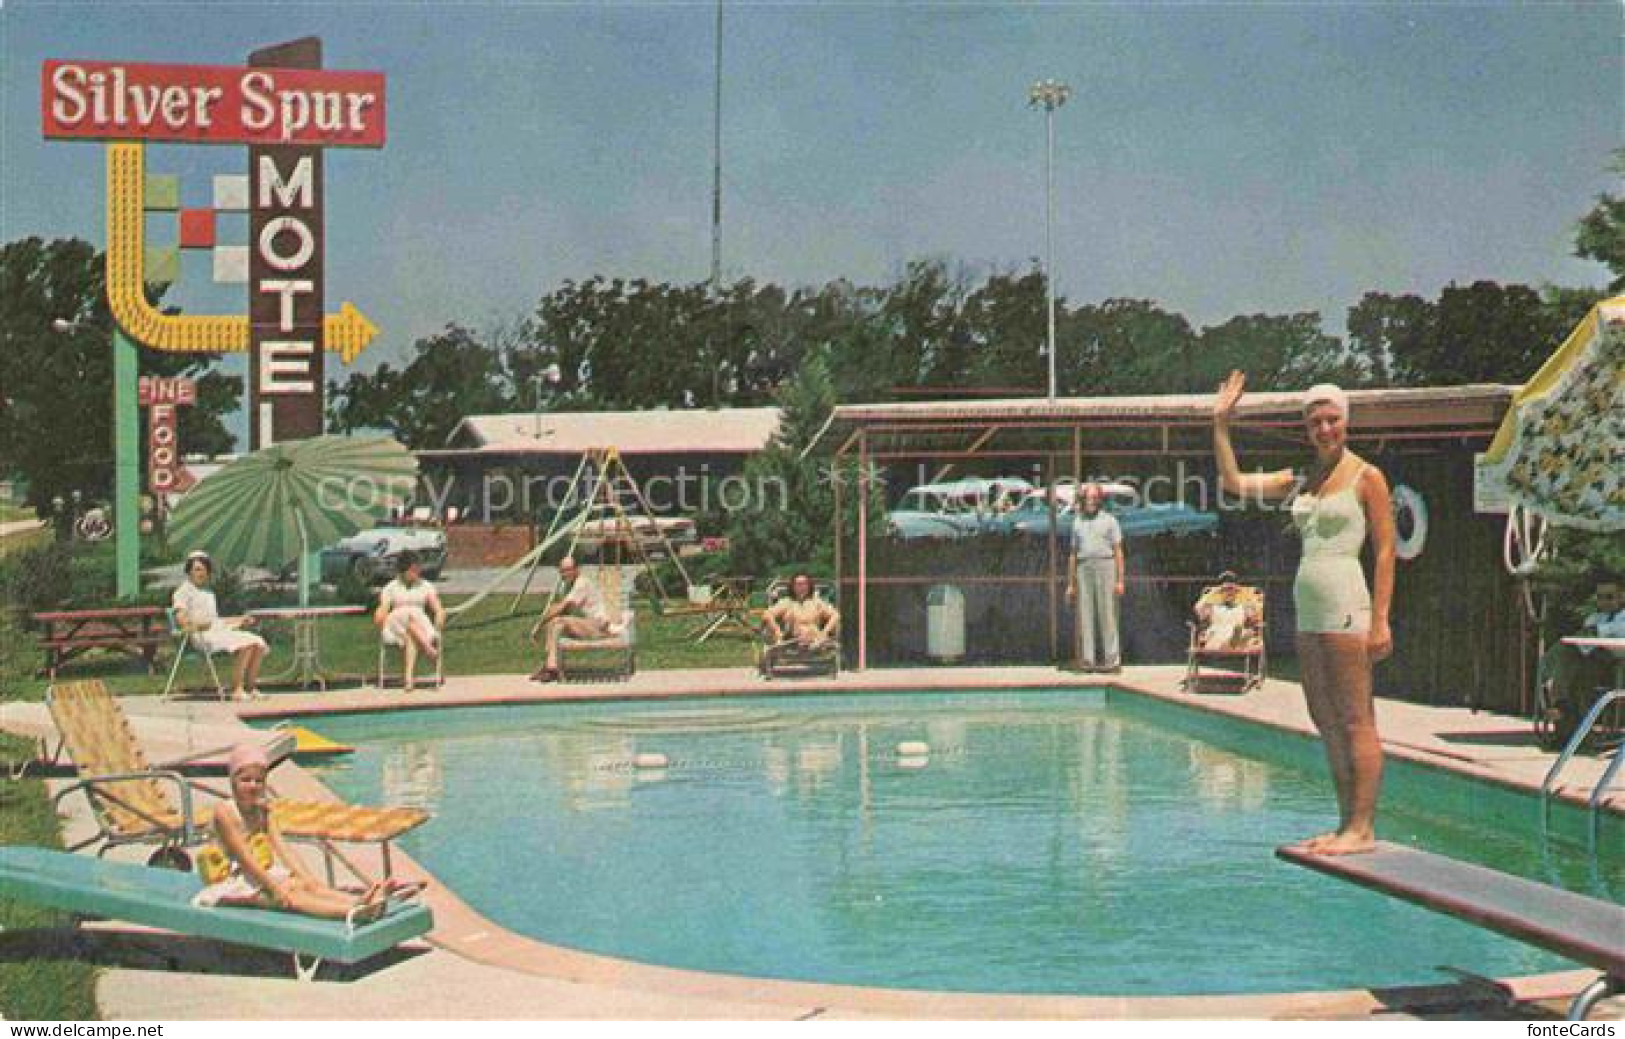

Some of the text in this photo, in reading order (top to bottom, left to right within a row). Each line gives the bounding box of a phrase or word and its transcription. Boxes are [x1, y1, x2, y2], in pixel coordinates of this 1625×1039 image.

[52, 65, 375, 139] Silver Spur
[152, 404, 173, 486] FOOD
